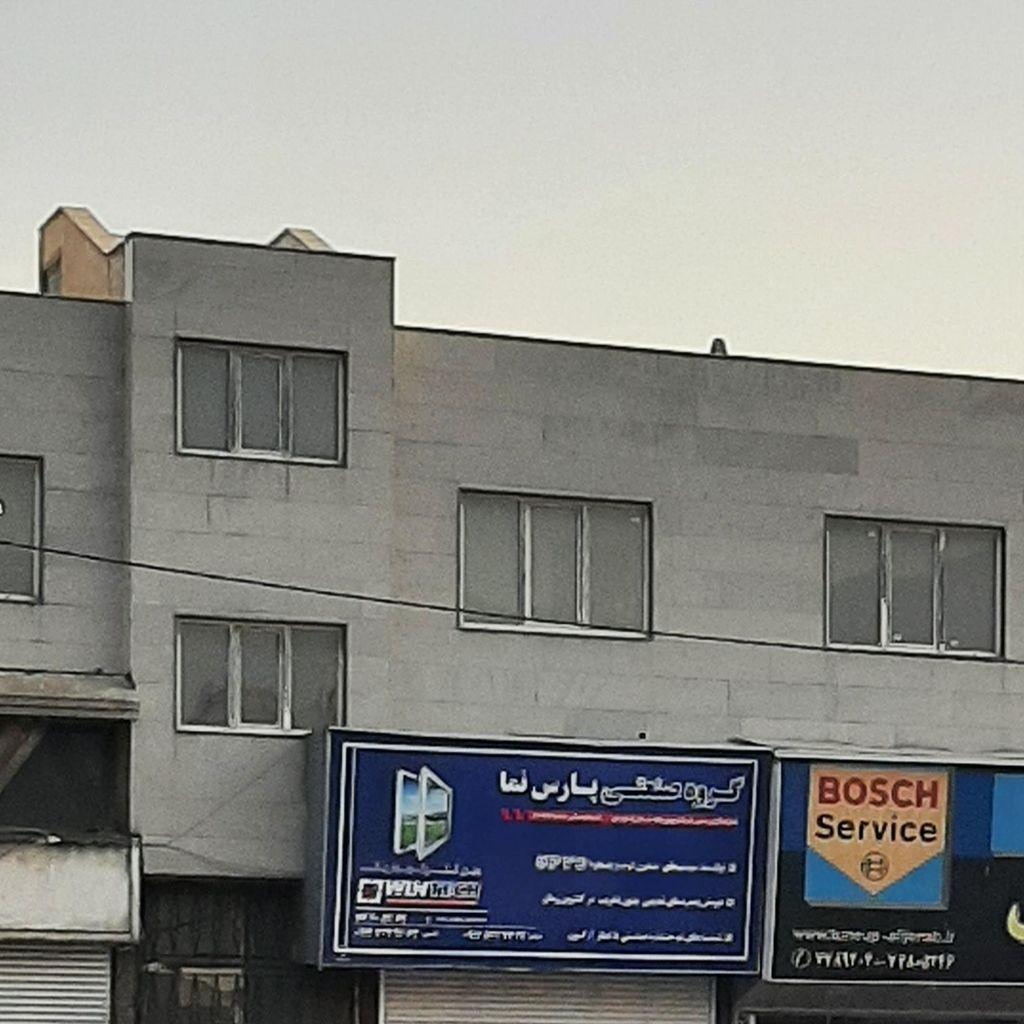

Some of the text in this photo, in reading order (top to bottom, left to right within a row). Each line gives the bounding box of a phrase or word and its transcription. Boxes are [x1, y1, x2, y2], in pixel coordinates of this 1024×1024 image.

[499, 769, 529, 794] نما
[531, 770, 599, 804] پارس
[818, 776, 939, 809] BOSCH
[815, 812, 938, 844] Service
